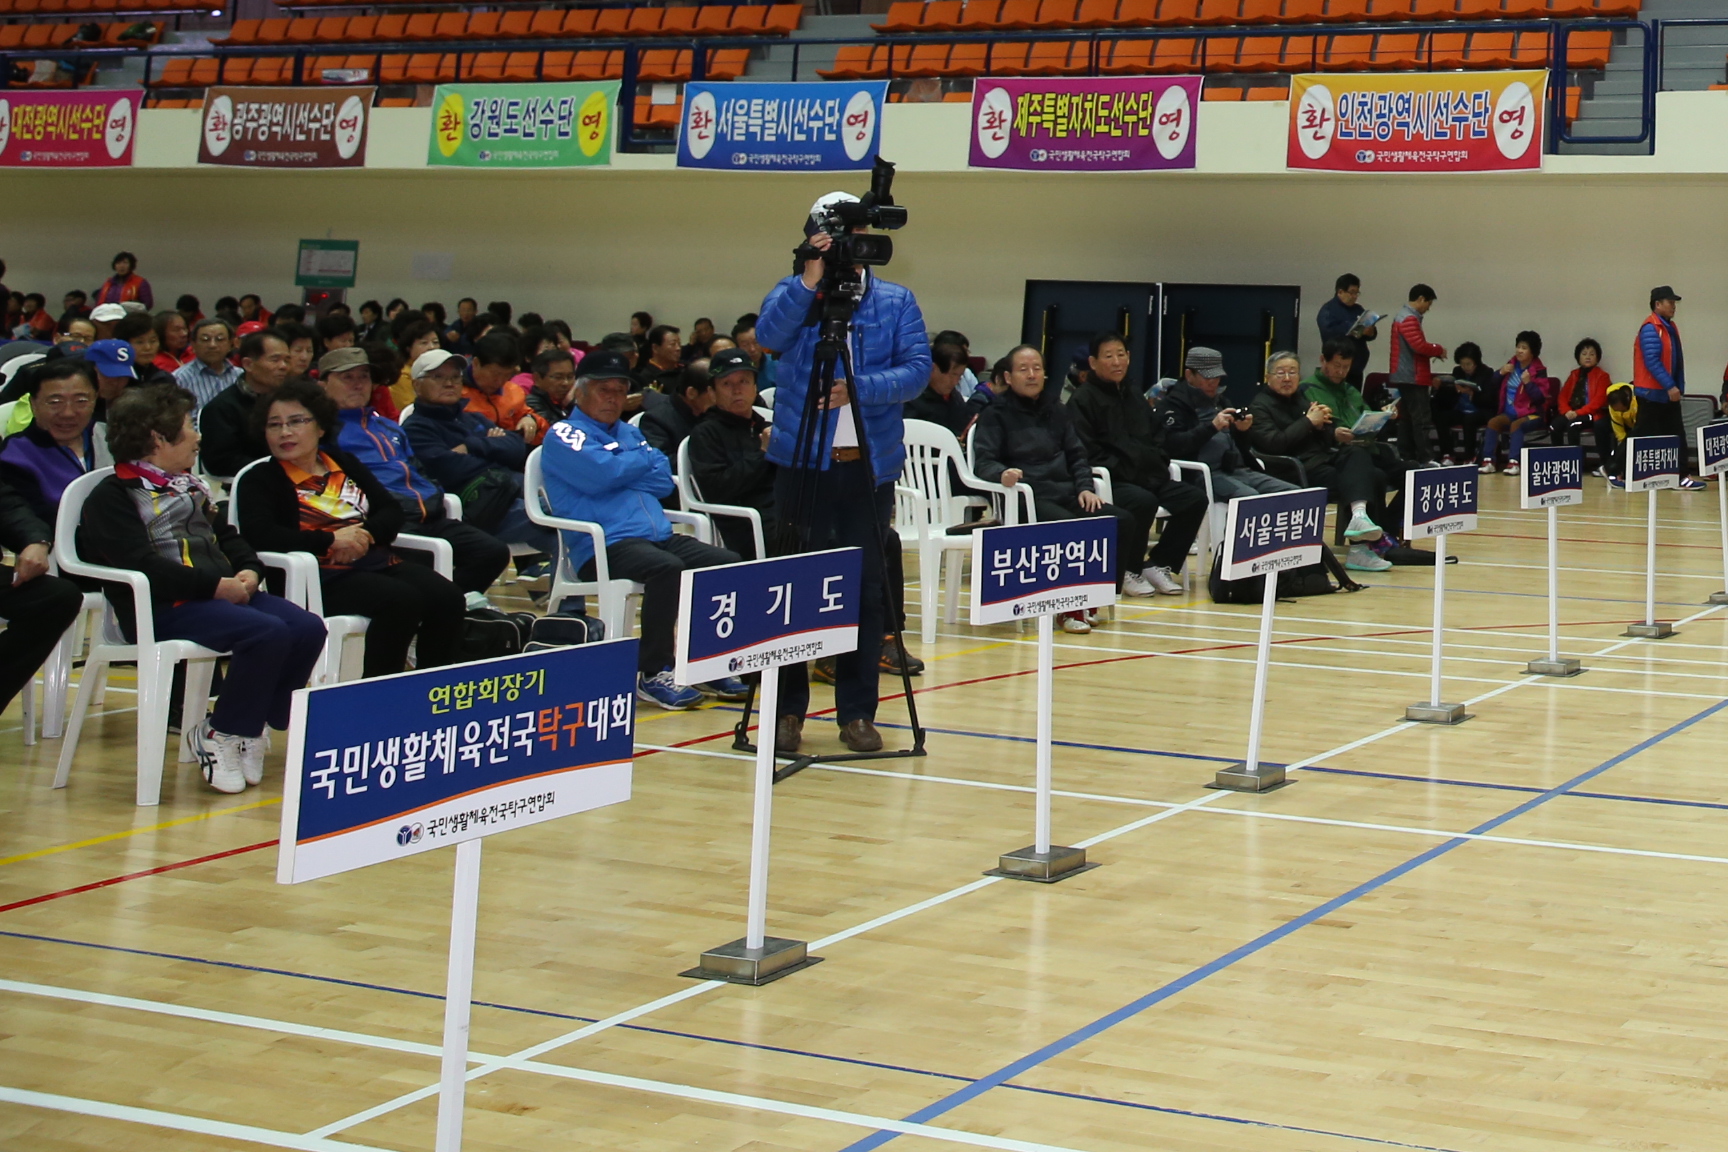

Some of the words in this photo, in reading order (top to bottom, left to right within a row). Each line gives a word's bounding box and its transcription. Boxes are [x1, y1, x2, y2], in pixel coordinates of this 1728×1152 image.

[11, 104, 107, 140] 대전광역시선수단
[110, 116, 126, 142] 영
[209, 110, 228, 142] 환
[232, 102, 335, 141] 광주광역시선수단
[339, 116, 358, 143] 영
[439, 109, 461, 141] 환
[469, 97, 576, 140] 강원도선수단
[582, 111, 602, 141] 영
[690, 106, 713, 140] 환
[717, 98, 841, 142] 서울특별시선수단
[846, 110, 870, 141] 영
[982, 105, 1008, 141] 환
[1013, 91, 1154, 139] 제주특별자치도선수단
[1159, 108, 1183, 141] 영
[1301, 103, 1331, 141] 환
[1337, 90, 1491, 141] 인천광역시선수단
[1499, 106, 1526, 140] 영
[1376, 150, 1468, 163] 국민생활체육전국탁구연합회
[117, 347, 129, 361] S
[1532, 459, 1580, 486] 울산광역시
[1635, 448, 1679, 472] 세종특별자치시
[1420, 481, 1472, 513] 경상북도
[1240, 506, 1320, 548] 서울특별시
[991, 538, 1108, 587] 부산광역시
[746, 641, 823, 668] 국민생활체육전국탁구연합회
[428, 669, 545, 715] 연합회장기
[309, 692, 633, 799] 국민생활체육전국탁구대회
[427, 791, 555, 838] 국민생활체육전국탁구연합회
